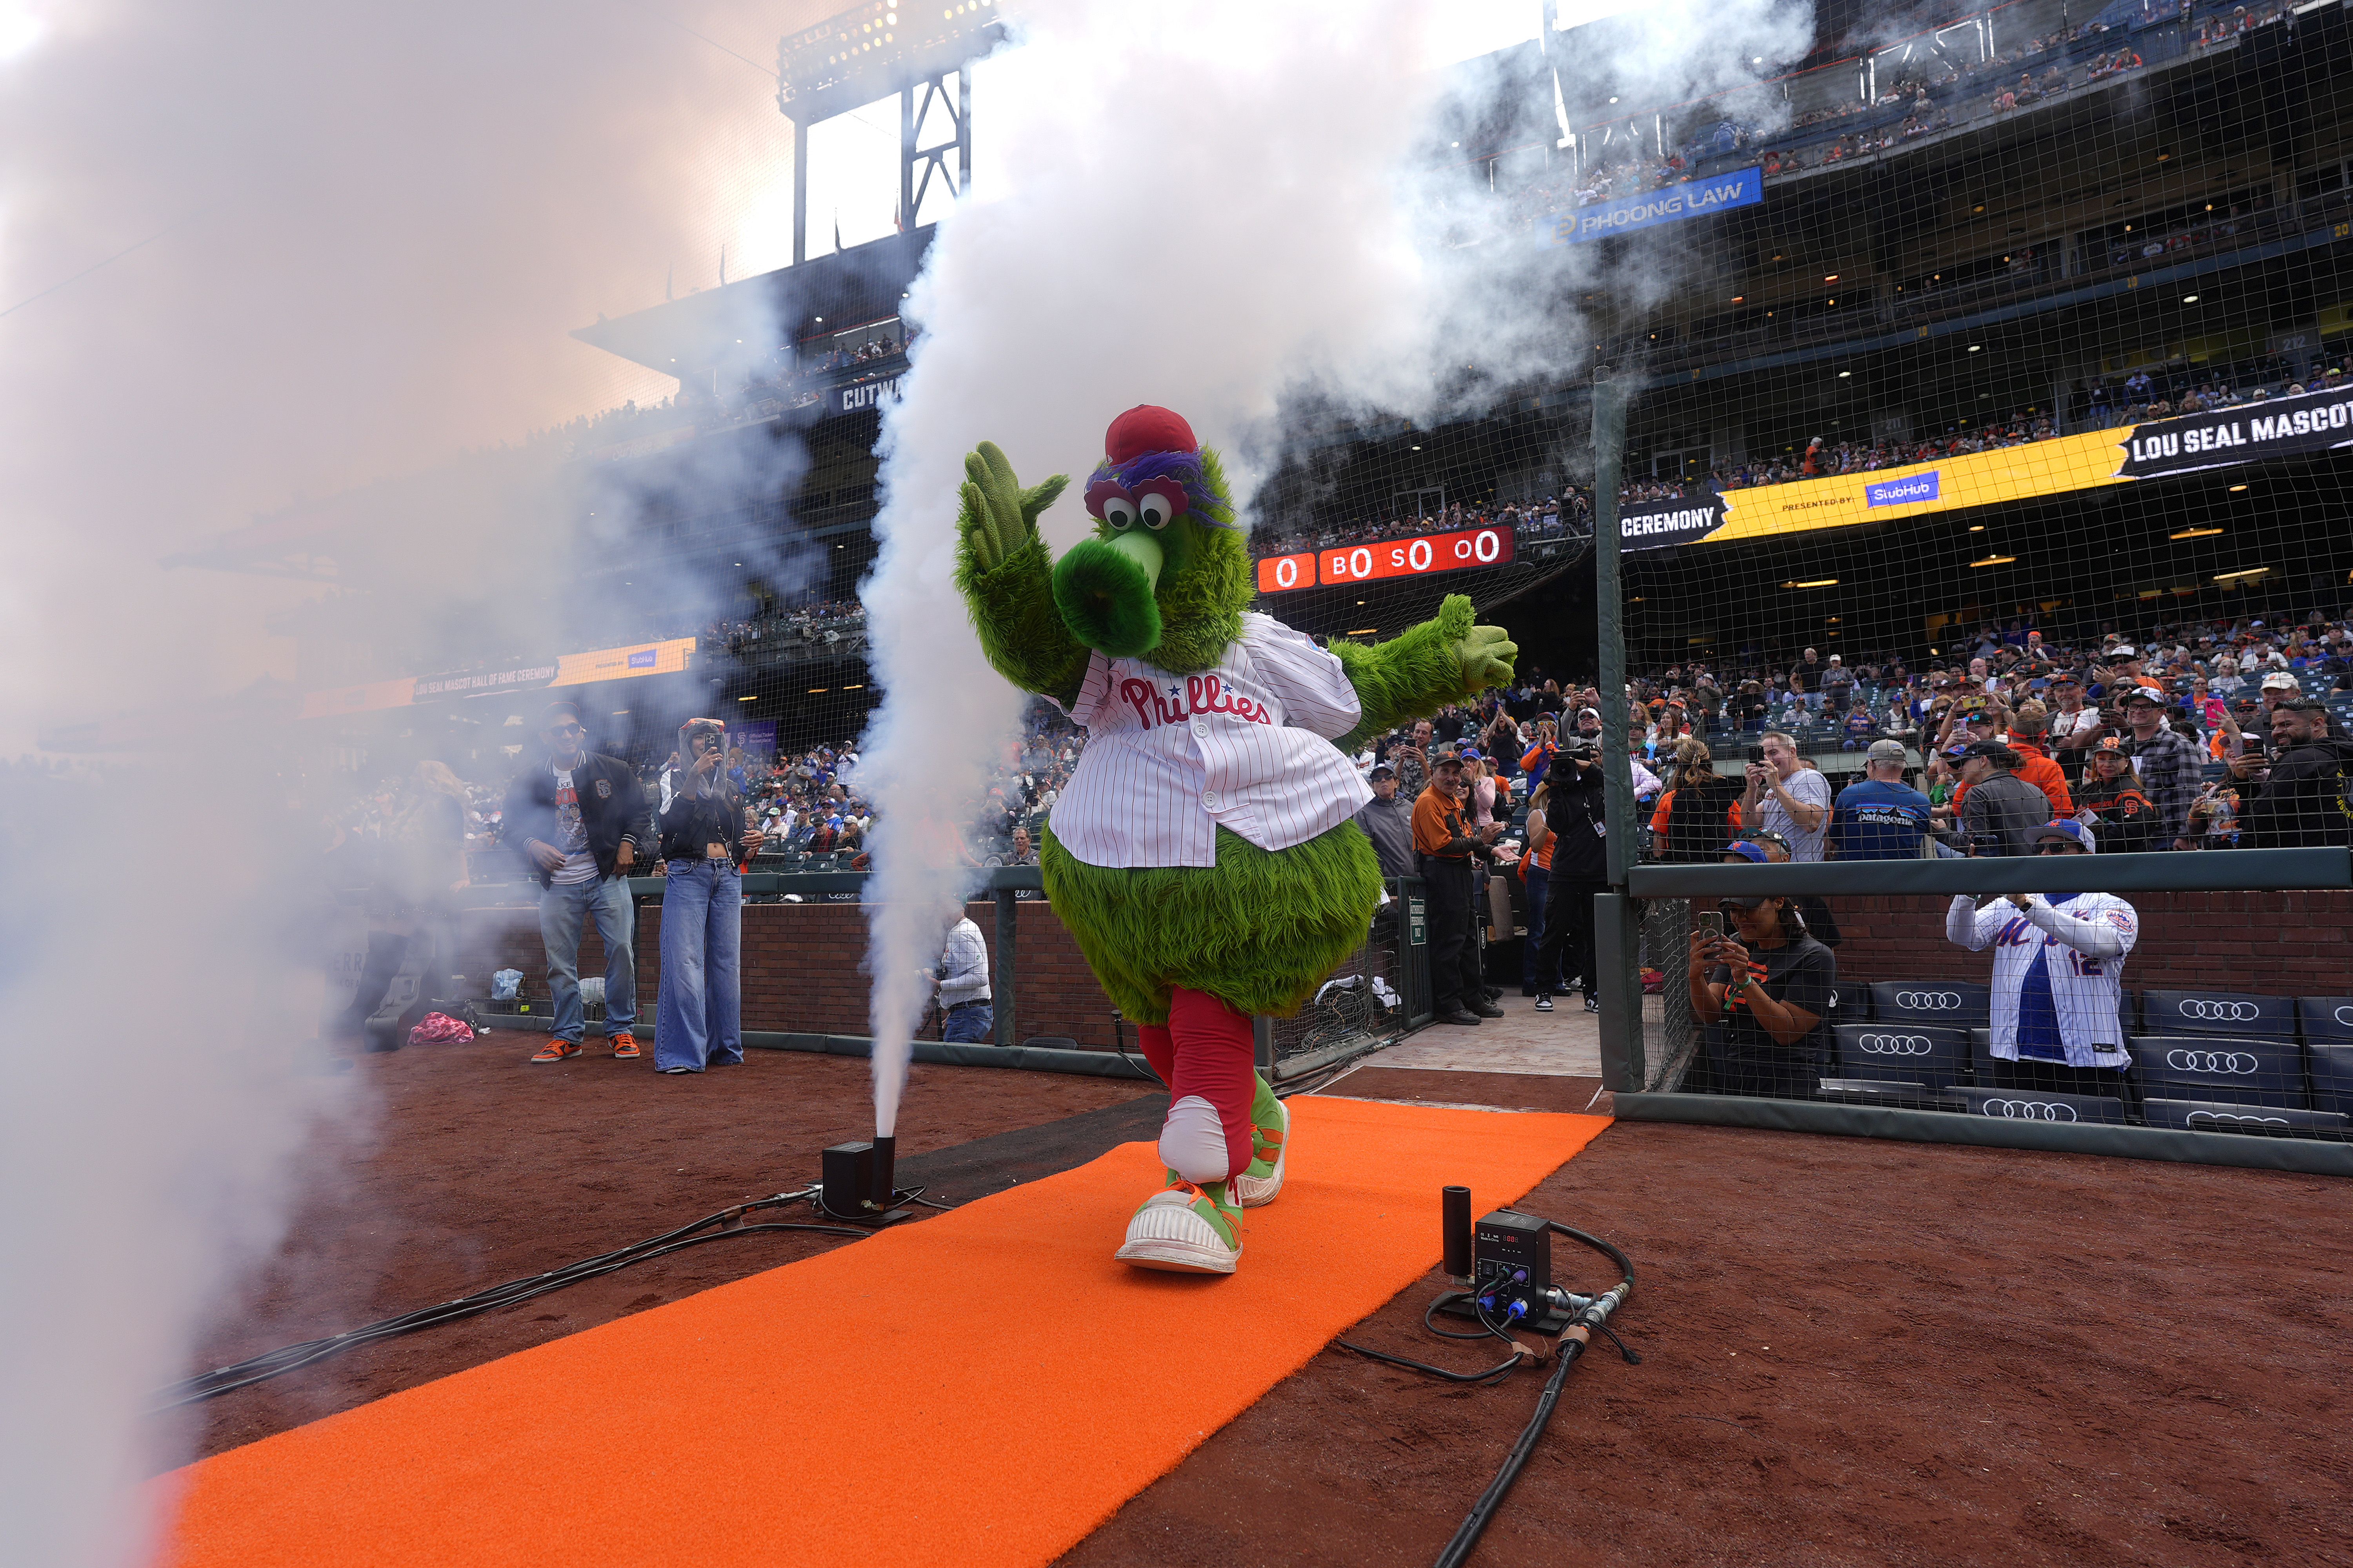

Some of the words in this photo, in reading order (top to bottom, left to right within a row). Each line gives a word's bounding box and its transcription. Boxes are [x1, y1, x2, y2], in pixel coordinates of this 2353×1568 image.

[1582, 197, 1682, 233] PHOONG
[1688, 182, 1743, 207] LAW
[2334, 223, 2349, 237] 20
[2284, 335, 2305, 350] 212
[2132, 432, 2179, 462] LOU
[2184, 422, 2246, 453] SEAL
[1621, 507, 1714, 537] CEREMONY
[1782, 499, 1836, 511] PRESENTED
[1874, 482, 1929, 501] StubHub
[1276, 558, 1298, 587] 0
[1333, 557, 1346, 575] B
[1350, 548, 1372, 578] 0
[1391, 549, 1405, 567] S
[1409, 540, 1433, 570] 0
[415, 683, 427, 695] LOU
[428, 681, 444, 693] SEAL
[445, 677, 471, 691] MASCOT
[472, 674, 487, 687] HALL
[489, 673, 497, 685] OF
[498, 670, 516, 684] FAME
[517, 666, 555, 681] CEREMONY
[1120, 674, 1271, 730] Phillies
[2069, 948, 2103, 976] 12
